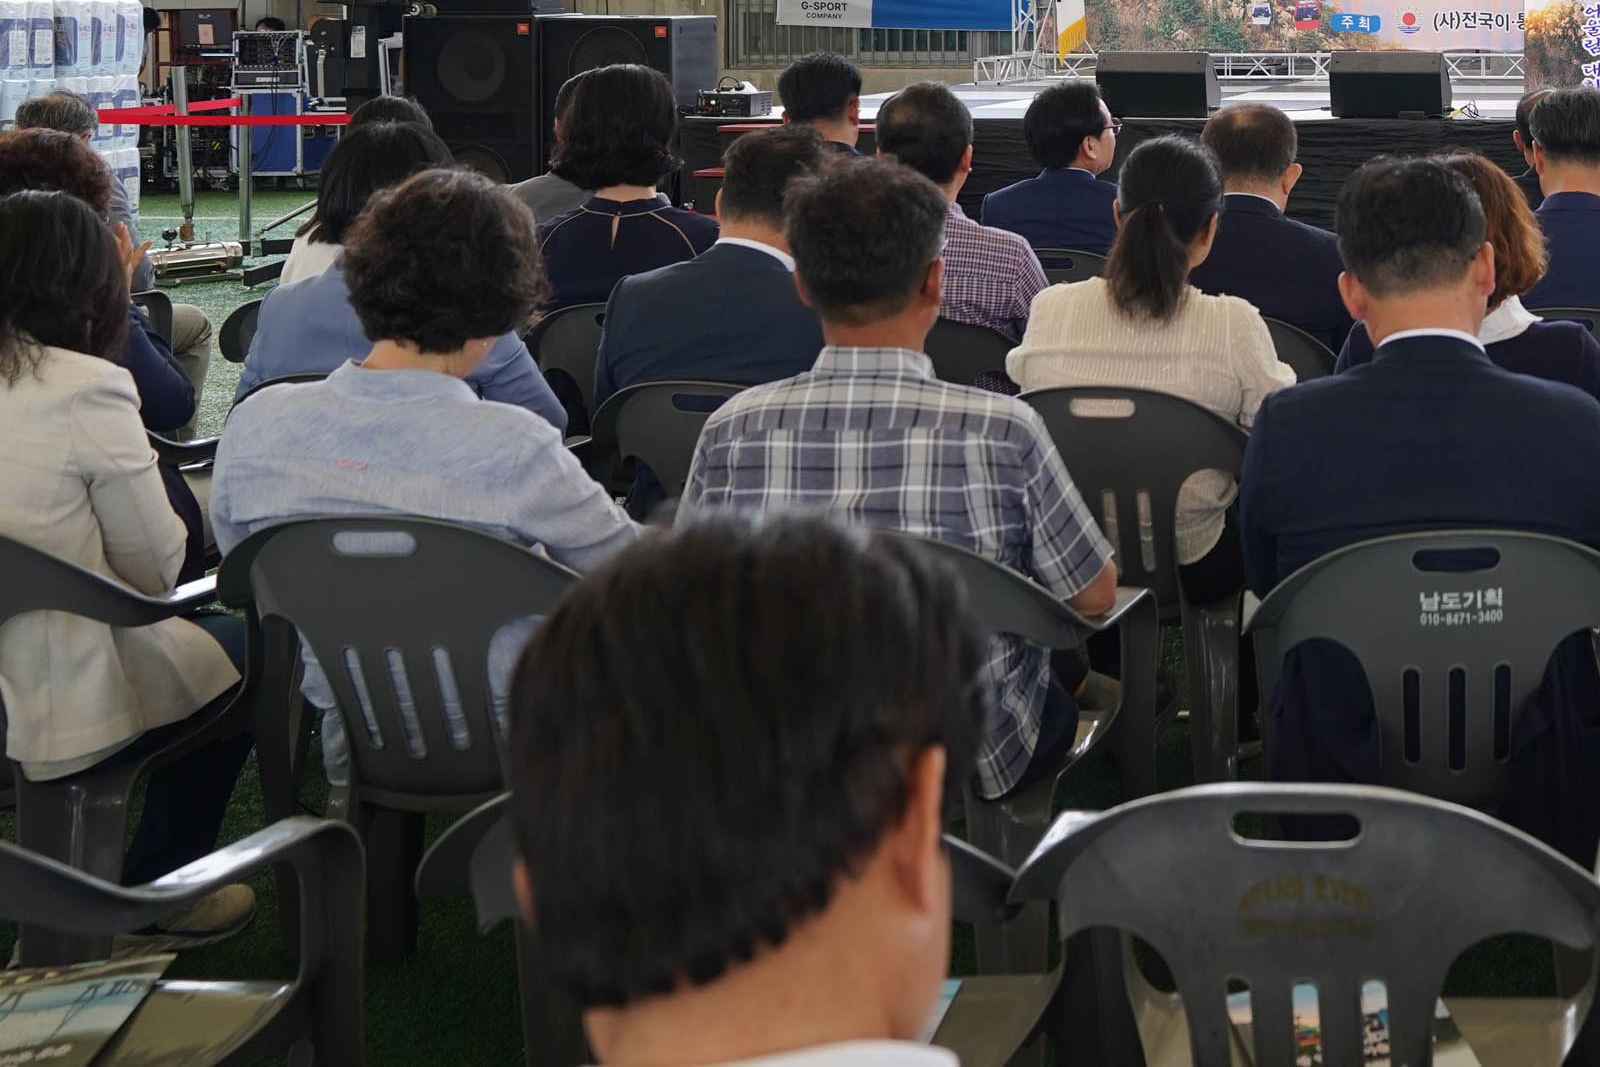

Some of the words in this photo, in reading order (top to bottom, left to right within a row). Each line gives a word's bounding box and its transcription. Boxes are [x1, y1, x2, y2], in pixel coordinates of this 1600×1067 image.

[801, 1, 848, 12] G-SPORT
[806, 12, 843, 20] COMPANY
[1419, 587, 1504, 612] 남도기획
[1419, 608, 1504, 626] 010-8471-3400
